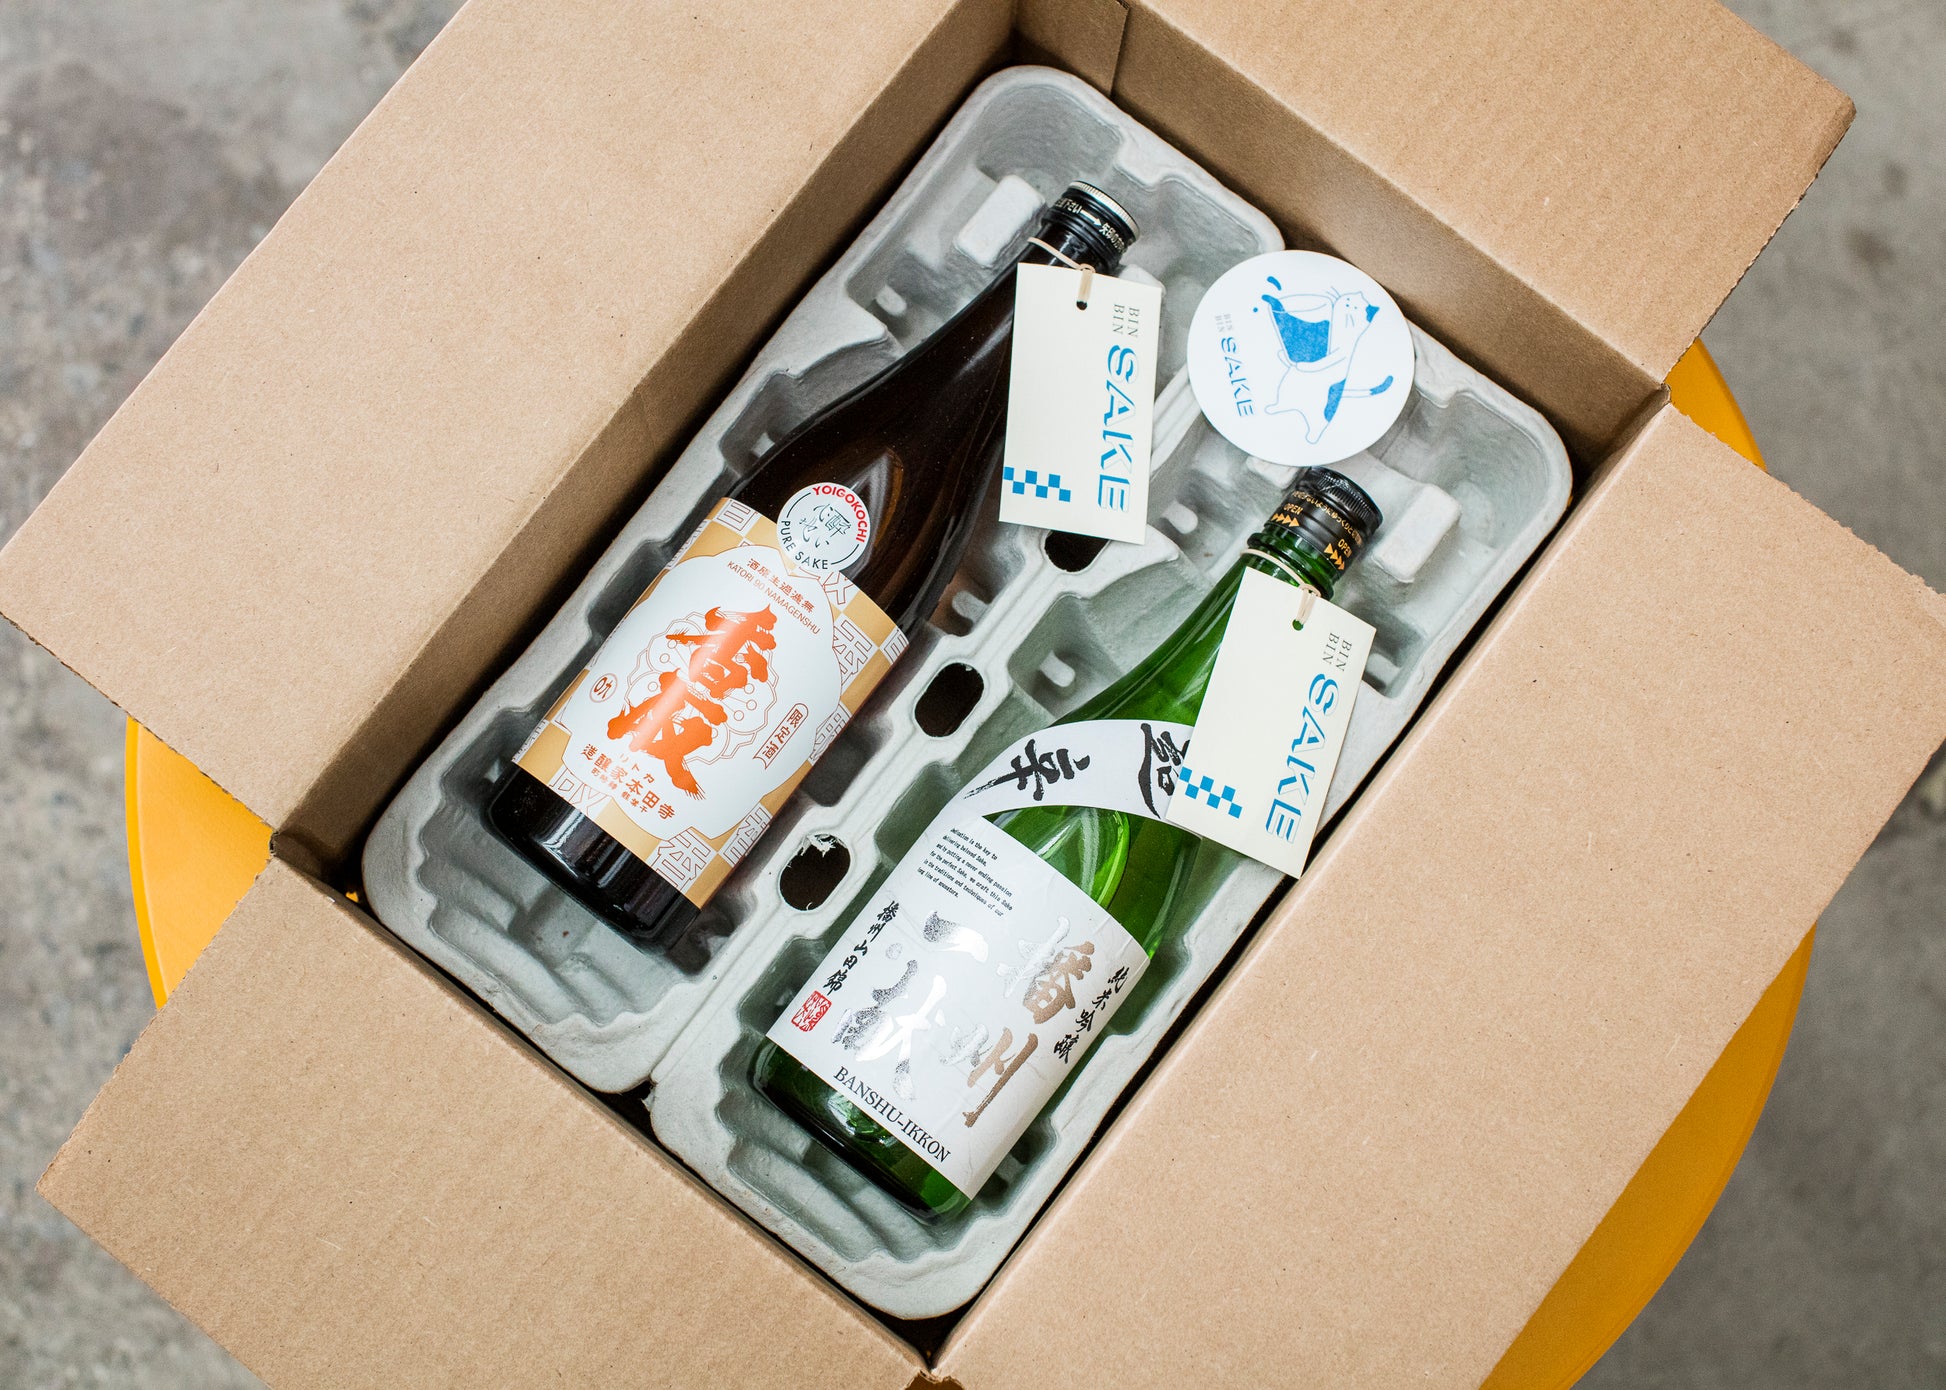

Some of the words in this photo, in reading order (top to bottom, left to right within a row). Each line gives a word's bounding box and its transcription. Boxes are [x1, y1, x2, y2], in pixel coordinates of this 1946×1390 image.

[1112, 303, 1125, 335] BIN
[1127, 307, 1140, 338] BIN
[1221, 337, 1254, 417] SAKE
[1098, 344, 1139, 513] SAKE
[812, 485, 868, 543] YOIGOKOCHI
[1283, 503, 1303, 515] OPEN
[780, 520, 797, 552] PURE
[795, 551, 828, 570] SAKE
[1338, 539, 1352, 558] OPEN
[727, 561, 754, 582] KATORI
[754, 579, 765, 591] 90
[765, 587, 820, 635] NAMAGENSHU
[1321, 632, 1340, 665] BIN
[1336, 637, 1352, 672] BIN
[762, 708, 804, 760] 限定酒
[1265, 673, 1340, 845] SAKE
[934, 863, 954, 881] traditions
[954, 878, 964, 887] and
[947, 849, 961, 861] putting
[978, 870, 994, 884] ending
[993, 881, 1013, 897] passion
[960, 845, 976, 859] beloved
[975, 841, 983, 850] the
[983, 847, 991, 856] key
[992, 853, 998, 861] to
[942, 857, 957, 871] perfect
[1001, 899, 1013, 911] Sake
[833, 1066, 951, 1162] BANSHU-IKKON
